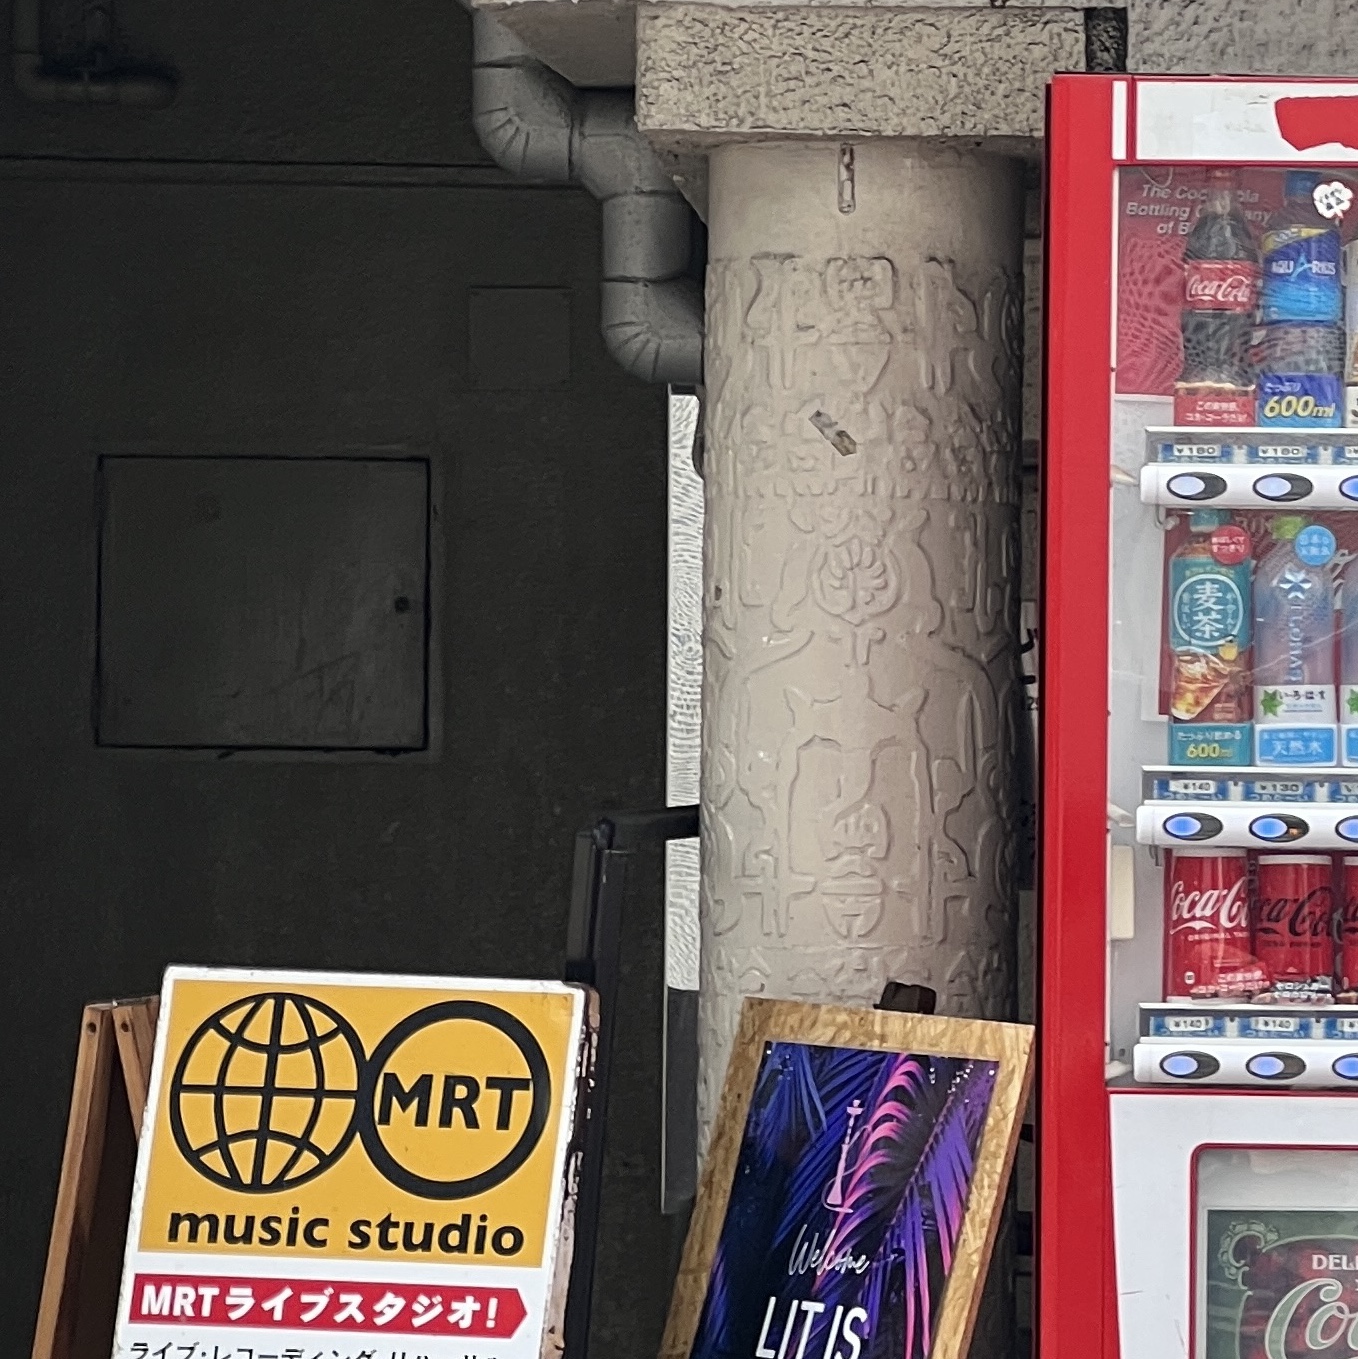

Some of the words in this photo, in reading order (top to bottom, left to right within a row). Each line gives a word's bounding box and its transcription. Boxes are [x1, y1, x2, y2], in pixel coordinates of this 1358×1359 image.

[1126, 202, 1190, 221] Bottling
[1263, 395, 1336, 419] 600ml
[1191, 581, 1225, 640] 麦茶
[376, 1072, 531, 1130] MRT
[167, 1207, 332, 1249] music
[347, 1212, 525, 1257] studio
[788, 1224, 870, 1275] Welcome
